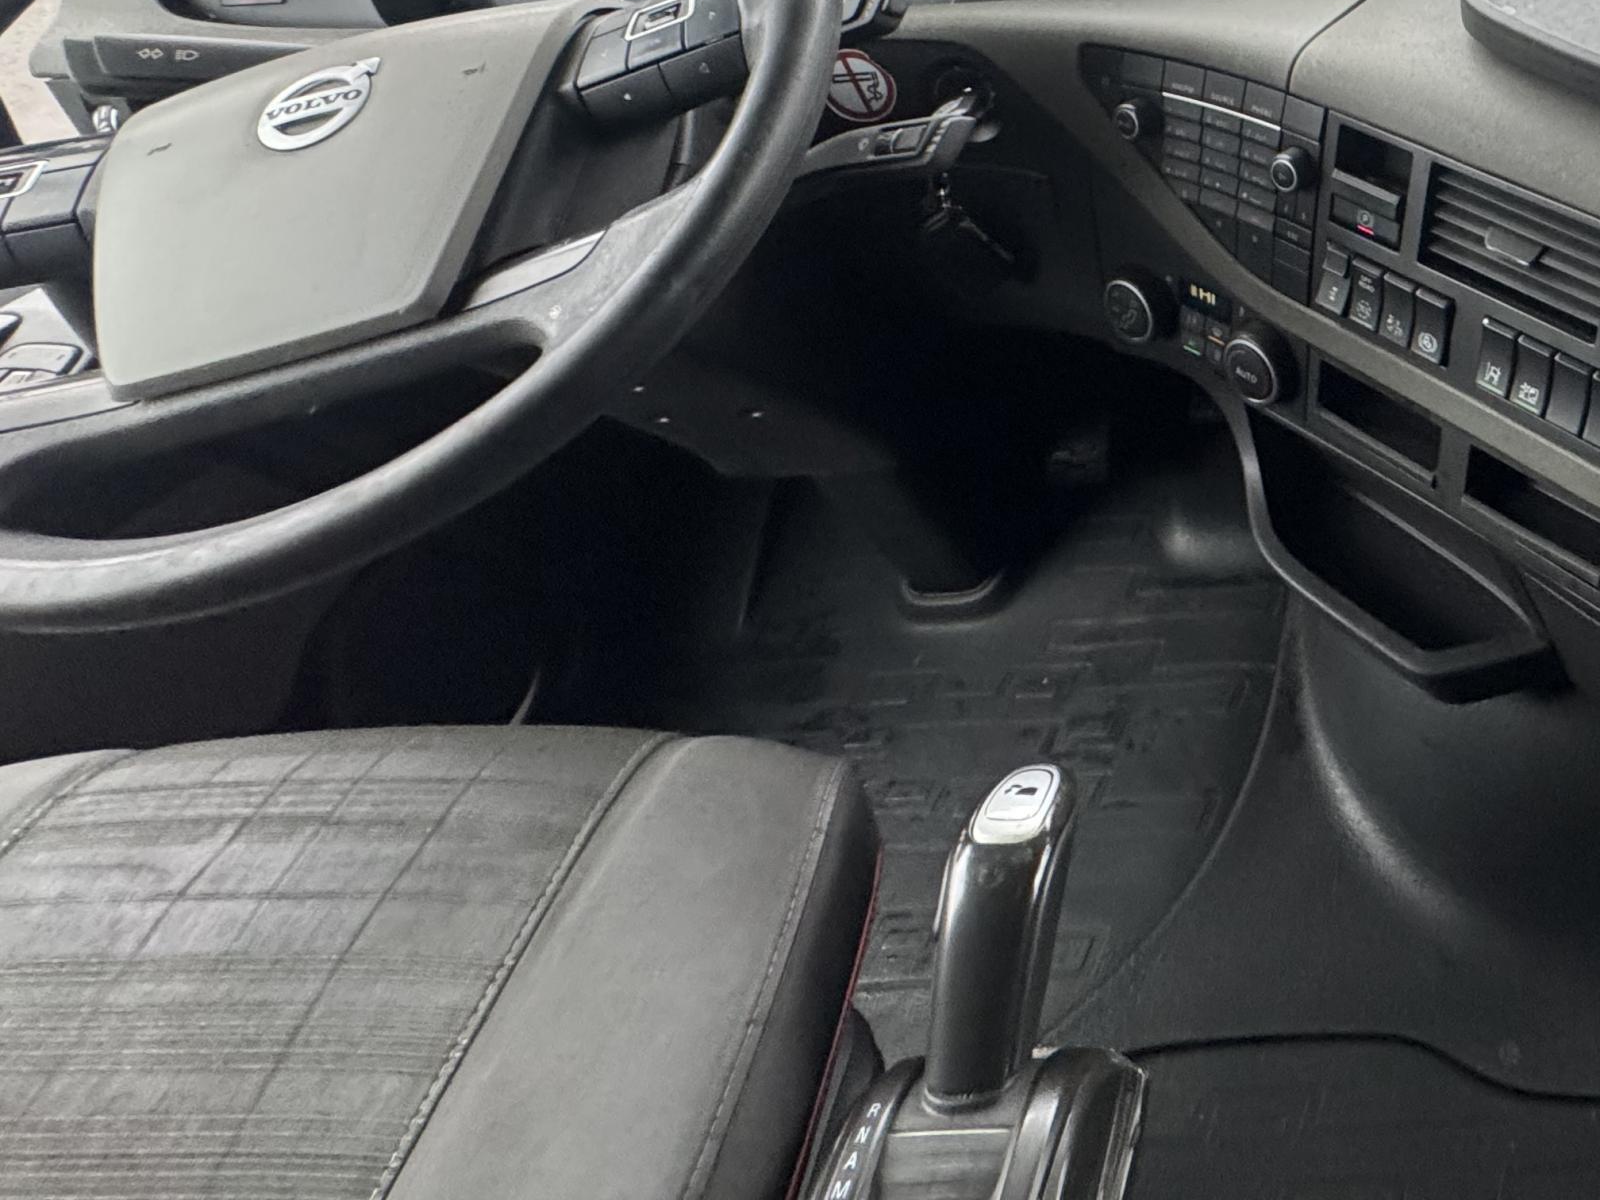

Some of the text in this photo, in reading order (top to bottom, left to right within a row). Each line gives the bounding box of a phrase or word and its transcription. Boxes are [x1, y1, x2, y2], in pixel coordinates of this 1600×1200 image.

[266, 89, 362, 120] VOLVO
[1235, 366, 1258, 384] AUTO
[867, 1102, 881, 1118] R
[854, 1126, 871, 1144] N
[843, 1151, 858, 1170] A
[831, 1179, 851, 1199] M
